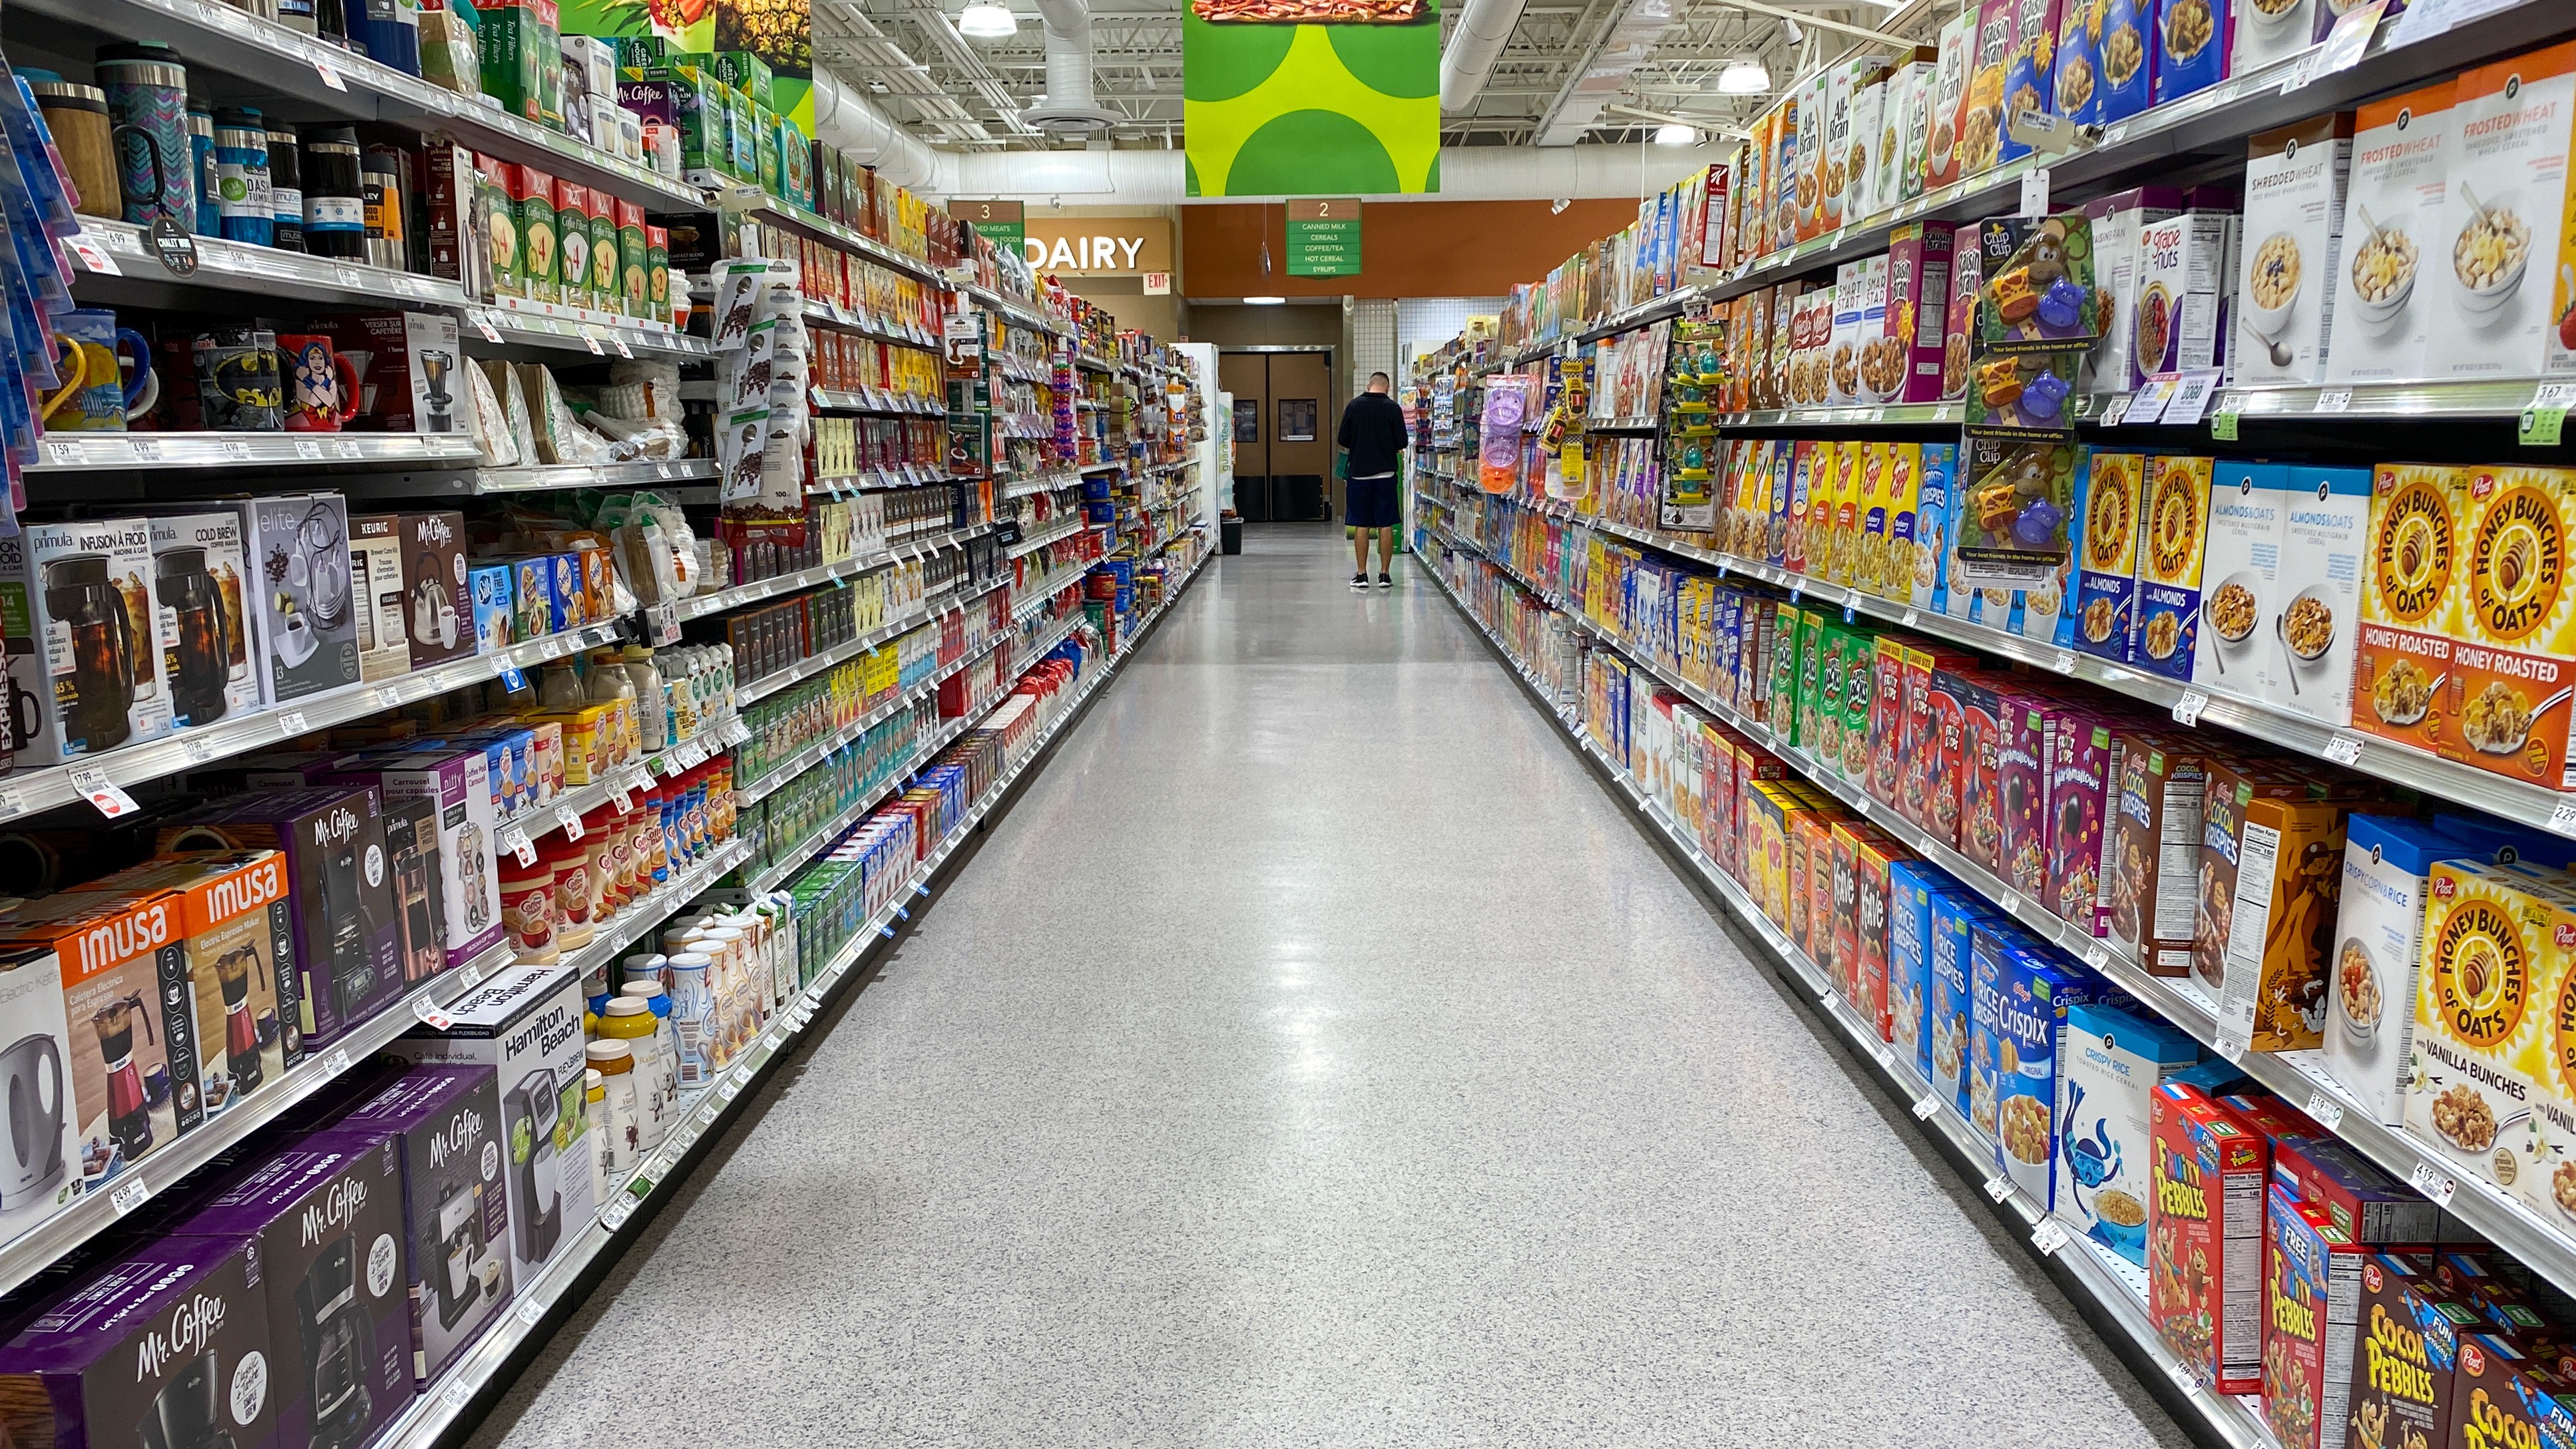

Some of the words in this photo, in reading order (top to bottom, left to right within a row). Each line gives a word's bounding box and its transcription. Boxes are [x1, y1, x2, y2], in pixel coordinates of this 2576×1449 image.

[1983, 18, 2010, 45] Raisin
[1982, 43, 2003, 69] Bran
[1938, 77, 1959, 106] Bran
[1800, 131, 1816, 156] Bran
[1829, 119, 1848, 143] Bran
[526, 204, 540, 218] Coffee
[540, 208, 554, 223] Filters
[562, 214, 574, 230] Coffee
[574, 219, 588, 232] Filters
[981, 204, 990, 219] 3
[1319, 202, 1329, 217] 2
[500, 227, 508, 254] 4
[538, 235, 546, 262] 4
[1924, 232, 1952, 242] Raisin
[1926, 241, 1949, 251] Bran
[1984, 232, 2009, 245] Chip
[1990, 244, 2012, 256] Clip
[2152, 228, 2180, 260] grape
[573, 244, 580, 270] 4
[602, 252, 610, 276] 4
[1024, 237, 1144, 269] DAIRY
[634, 276, 640, 299] 4
[1148, 274, 1165, 288] EXIT
[1838, 281, 1862, 294] SMART
[1837, 296, 1860, 311] START
[2181, 384, 2202, 401] BOGO
[1222, 421, 1231, 472] guarantee
[1976, 441, 2000, 451] Chip
[1980, 451, 2000, 464] Clip
[2092, 477, 2108, 526] HONEY
[2109, 472, 2127, 530] BUNCHES
[2473, 476, 2493, 499] Post
[260, 507, 294, 532] elite
[2155, 482, 2172, 533] HONEY
[2173, 475, 2191, 539] BUNCHES
[34, 530, 74, 553] primula
[80, 535, 116, 551] INFUSION
[126, 532, 146, 546] FROID
[196, 528, 214, 542] COLD
[216, 526, 238, 540] BREW
[361, 522, 388, 534] KEURIG
[2382, 494, 2409, 562] HONEY
[2412, 490, 2448, 571] BUNCHES
[2476, 500, 2511, 575] HONEY
[2514, 495, 2557, 585] BUNCHES
[2097, 538, 2119, 562] OATS
[2161, 546, 2185, 572] OATS
[2396, 580, 2436, 614] OATS
[2492, 596, 2541, 632] OATS
[1880, 642, 1890, 653] LARGE
[1891, 646, 1900, 656] SIZE
[2366, 627, 2398, 648] HONEY
[2400, 634, 2450, 660] ROASTED
[2455, 646, 2495, 671] HONEY
[2496, 653, 2558, 683] ROASTED
[444, 773, 463, 794] nifty
[466, 767, 477, 778] Coffee
[478, 763, 487, 773] Pod
[468, 774, 485, 787] Carousel
[386, 787, 404, 796] pour
[405, 786, 439, 795] capsules
[2126, 771, 2147, 803] COCOA
[2120, 792, 2151, 829] KRISPIES
[2211, 801, 2235, 837] COCOA
[315, 818, 331, 847] Mr.
[331, 807, 358, 844] Coffee
[387, 818, 407, 836] primula
[2205, 823, 2238, 866] KRISPIES
[2435, 878, 2455, 896] Post
[521, 899, 542, 913] Coffee
[1898, 905, 1915, 932] RICE
[200, 936, 220, 950] Electric
[221, 926, 243, 943] Espresso
[244, 917, 260, 932] Maker
[1893, 925, 1922, 966] KRISPIES
[2556, 926, 2576, 944] Post
[1938, 934, 1956, 962] RICE
[2440, 908, 2475, 974] HONEY
[2477, 908, 2521, 1006] BUNCHES
[1934, 950, 1965, 994] KRISPIES
[487, 969, 554, 1006] Hamilton
[1978, 980, 1998, 1008] RICE
[2053, 994, 2089, 1008] Crispix
[71, 1002, 85, 1019] para
[87, 990, 114, 1010] Espresso
[453, 988, 507, 1015] Beach
[505, 1006, 564, 1062] Hamilton
[1999, 994, 2049, 1047] Crispix
[2457, 1009, 2506, 1040] OATS
[541, 1015, 580, 1058] Beach
[414, 1051, 433, 1060] Café
[435, 1052, 477, 1061] individual,
[2085, 1047, 2111, 1068] CRISPY
[2112, 1058, 2130, 1077] RICE
[2426, 1039, 2468, 1072] VANILLA
[2470, 1059, 2526, 1101] BUNCHES
[430, 1132, 450, 1169] Mr.
[449, 1108, 483, 1157] Coffee
[2202, 1132, 2217, 1151] FUN
[2153, 1165, 2208, 1221] PEBBLES
[302, 1205, 326, 1247] Mr.
[325, 1177, 367, 1231] Coffee
[2286, 1225, 2307, 1259] FREE
[2365, 1267, 2380, 1287] Post
[2269, 1277, 2316, 1342] PEBBLES
[136, 1332, 170, 1382] Mr.
[171, 1293, 226, 1357] Coffee
[2370, 1303, 2428, 1369] COCOA
[2433, 1315, 2453, 1343] FUN
[2364, 1336, 2434, 1404] PEBBLES
[2464, 1348, 2482, 1370] Post
[2470, 1387, 2541, 1449] COCOA
